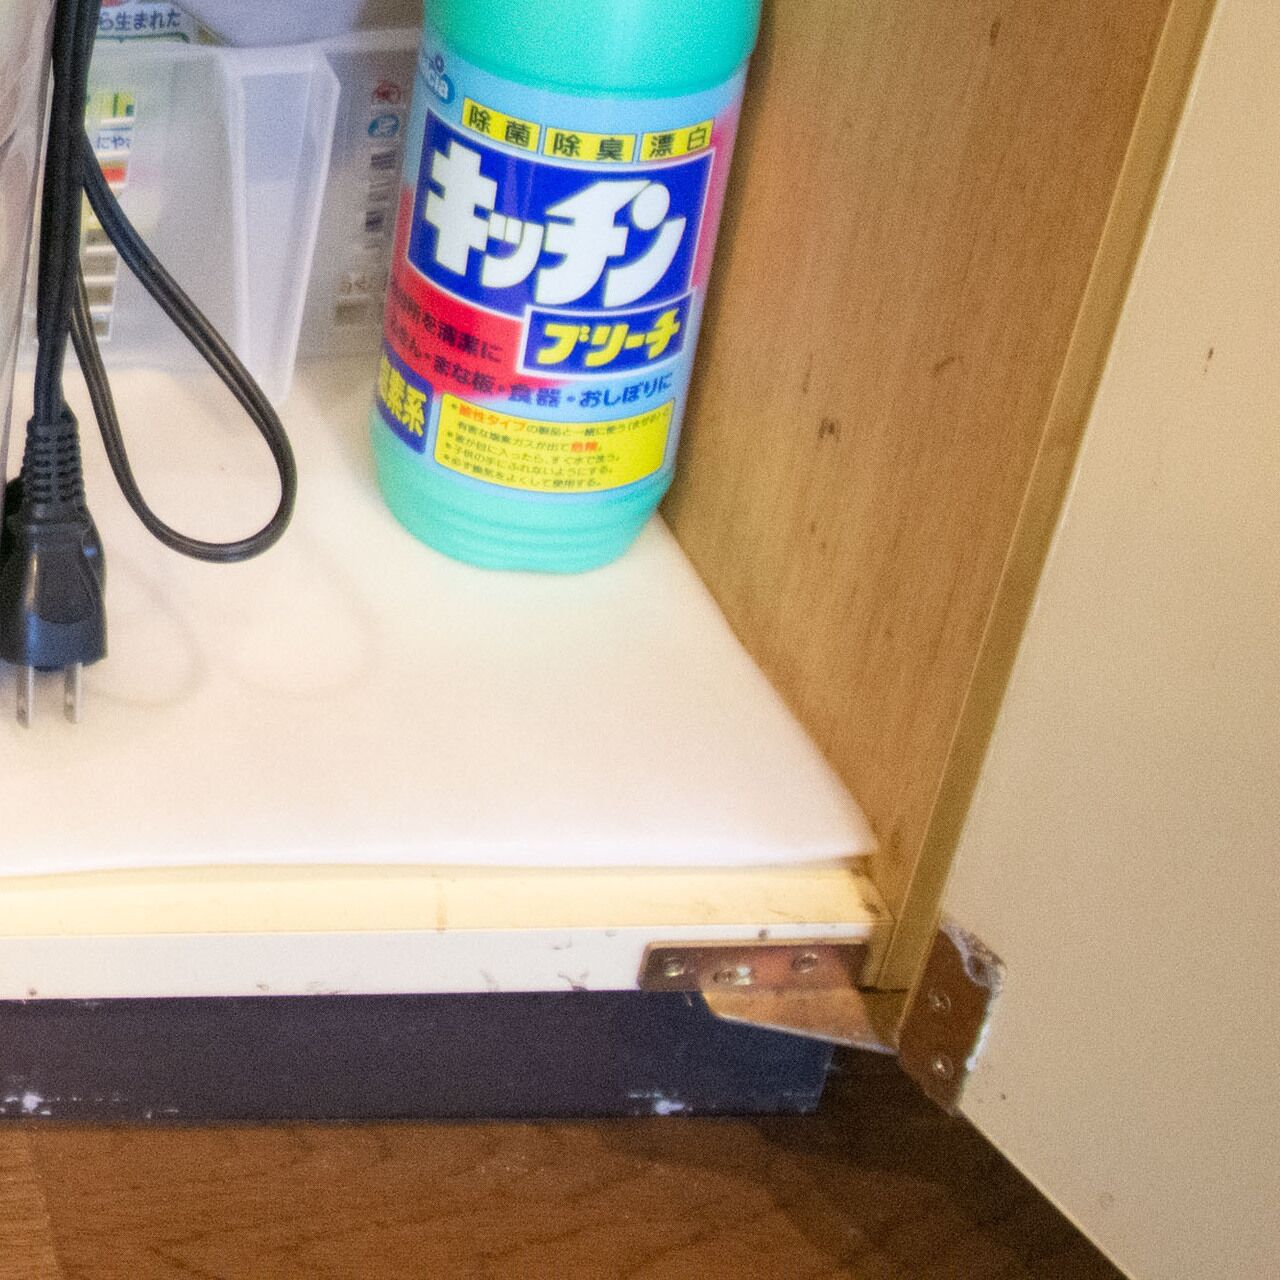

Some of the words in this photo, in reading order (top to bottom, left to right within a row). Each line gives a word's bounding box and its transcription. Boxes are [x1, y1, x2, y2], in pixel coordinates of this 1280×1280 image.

[468, 105, 532, 147] 除菌
[552, 132, 625, 161] 除臭
[648, 126, 708, 158] 漂白
[425, 139, 687, 308] キッチン
[536, 308, 681, 368] ブリーチ
[380, 355, 427, 437] 素系
